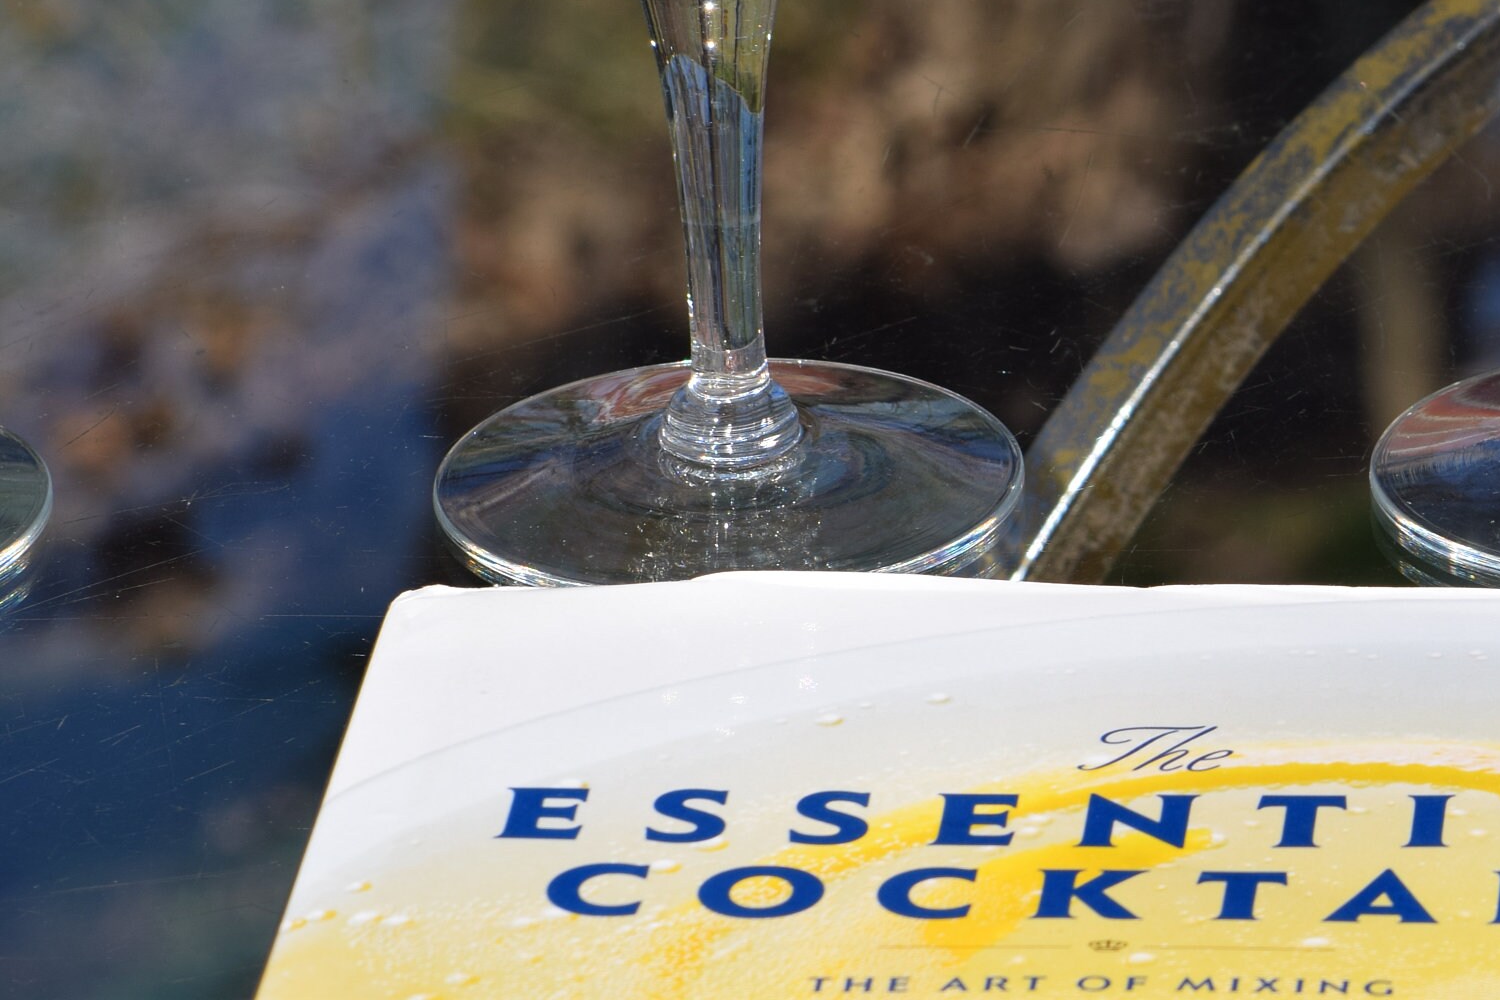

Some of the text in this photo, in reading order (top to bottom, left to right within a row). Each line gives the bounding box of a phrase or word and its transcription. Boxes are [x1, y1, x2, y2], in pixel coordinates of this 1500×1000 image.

[1077, 725, 1234, 773] The
[807, 975, 1397, 997] THE ART OF MIXING
